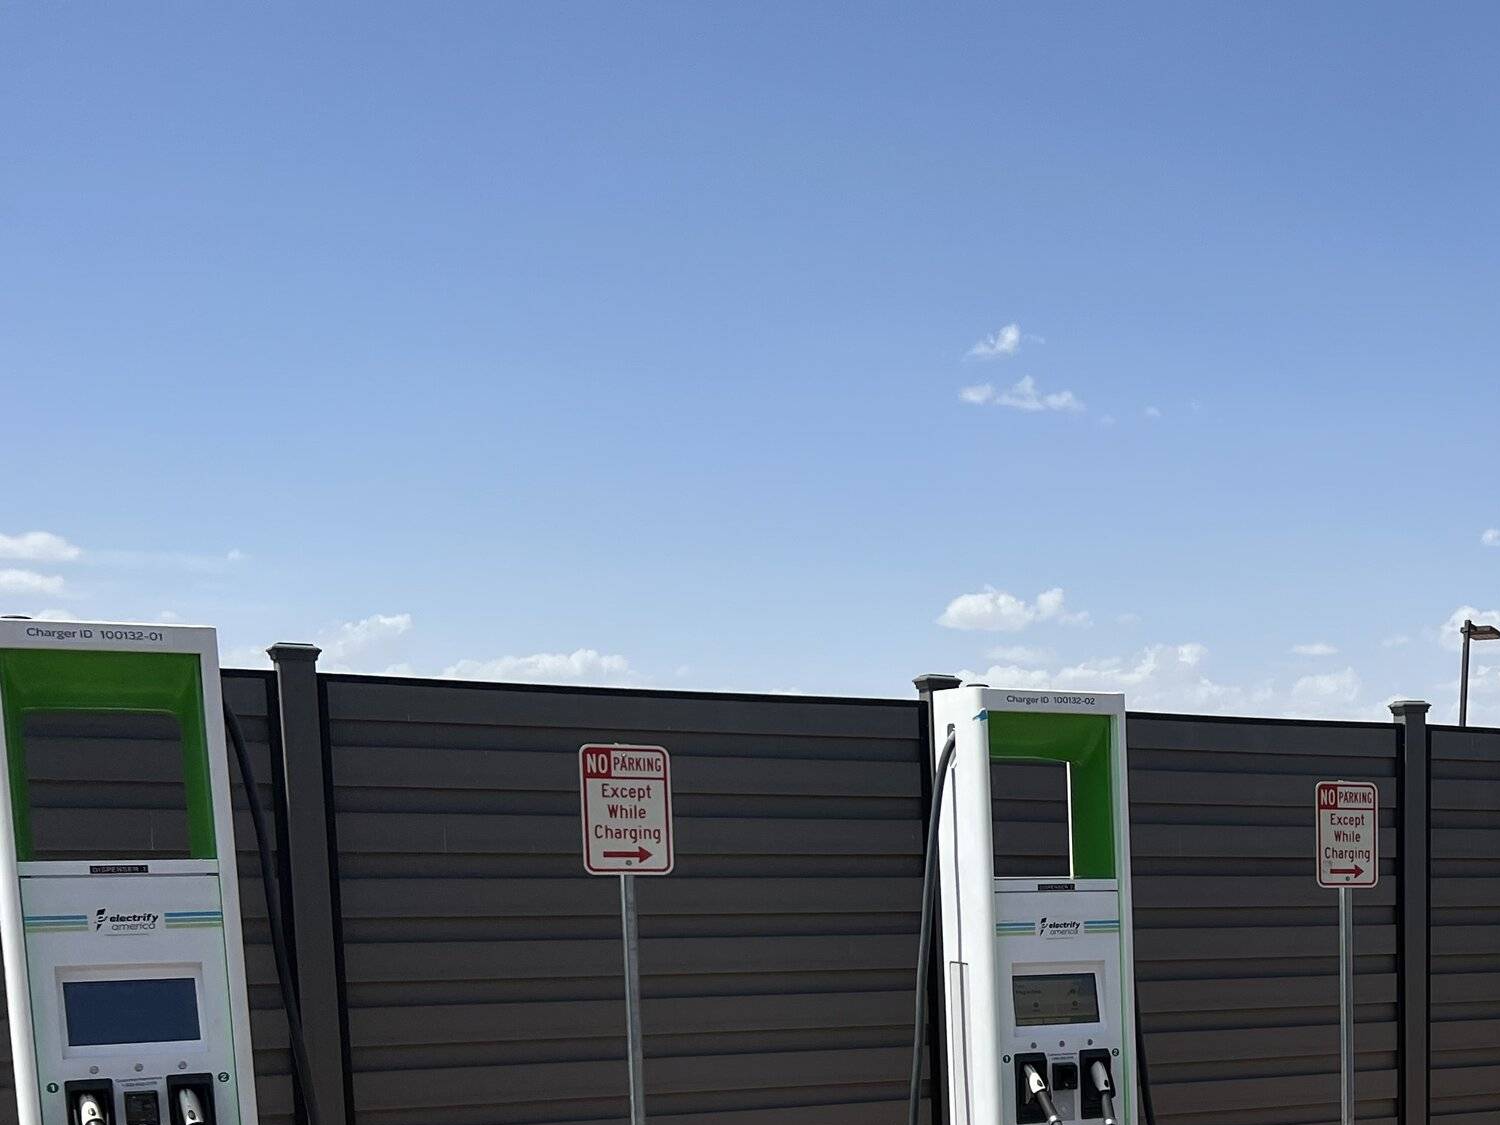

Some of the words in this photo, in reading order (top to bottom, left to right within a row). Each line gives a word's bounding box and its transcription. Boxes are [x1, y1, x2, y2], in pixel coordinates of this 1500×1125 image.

[26, 627, 77, 640] Charger
[79, 629, 93, 639] ID
[100, 630, 163, 641] 100132-01
[1006, 695, 1039, 705] Charger
[1040, 696, 1049, 704] ID
[1053, 696, 1095, 705] 100132-02
[586, 753, 608, 774] NO
[613, 756, 662, 773] PARKING
[601, 783, 652, 802] Except
[1320, 789, 1336, 806] NO
[1338, 791, 1373, 804] PARKING
[607, 804, 647, 819] While
[1330, 813, 1365, 827] Except
[594, 824, 662, 844] Charging
[1333, 830, 1361, 843] While
[1324, 847, 1371, 863] Charging
[109, 913, 158, 923] electrify
[1049, 921, 1080, 929] electrify
[112, 923, 156, 931] america
